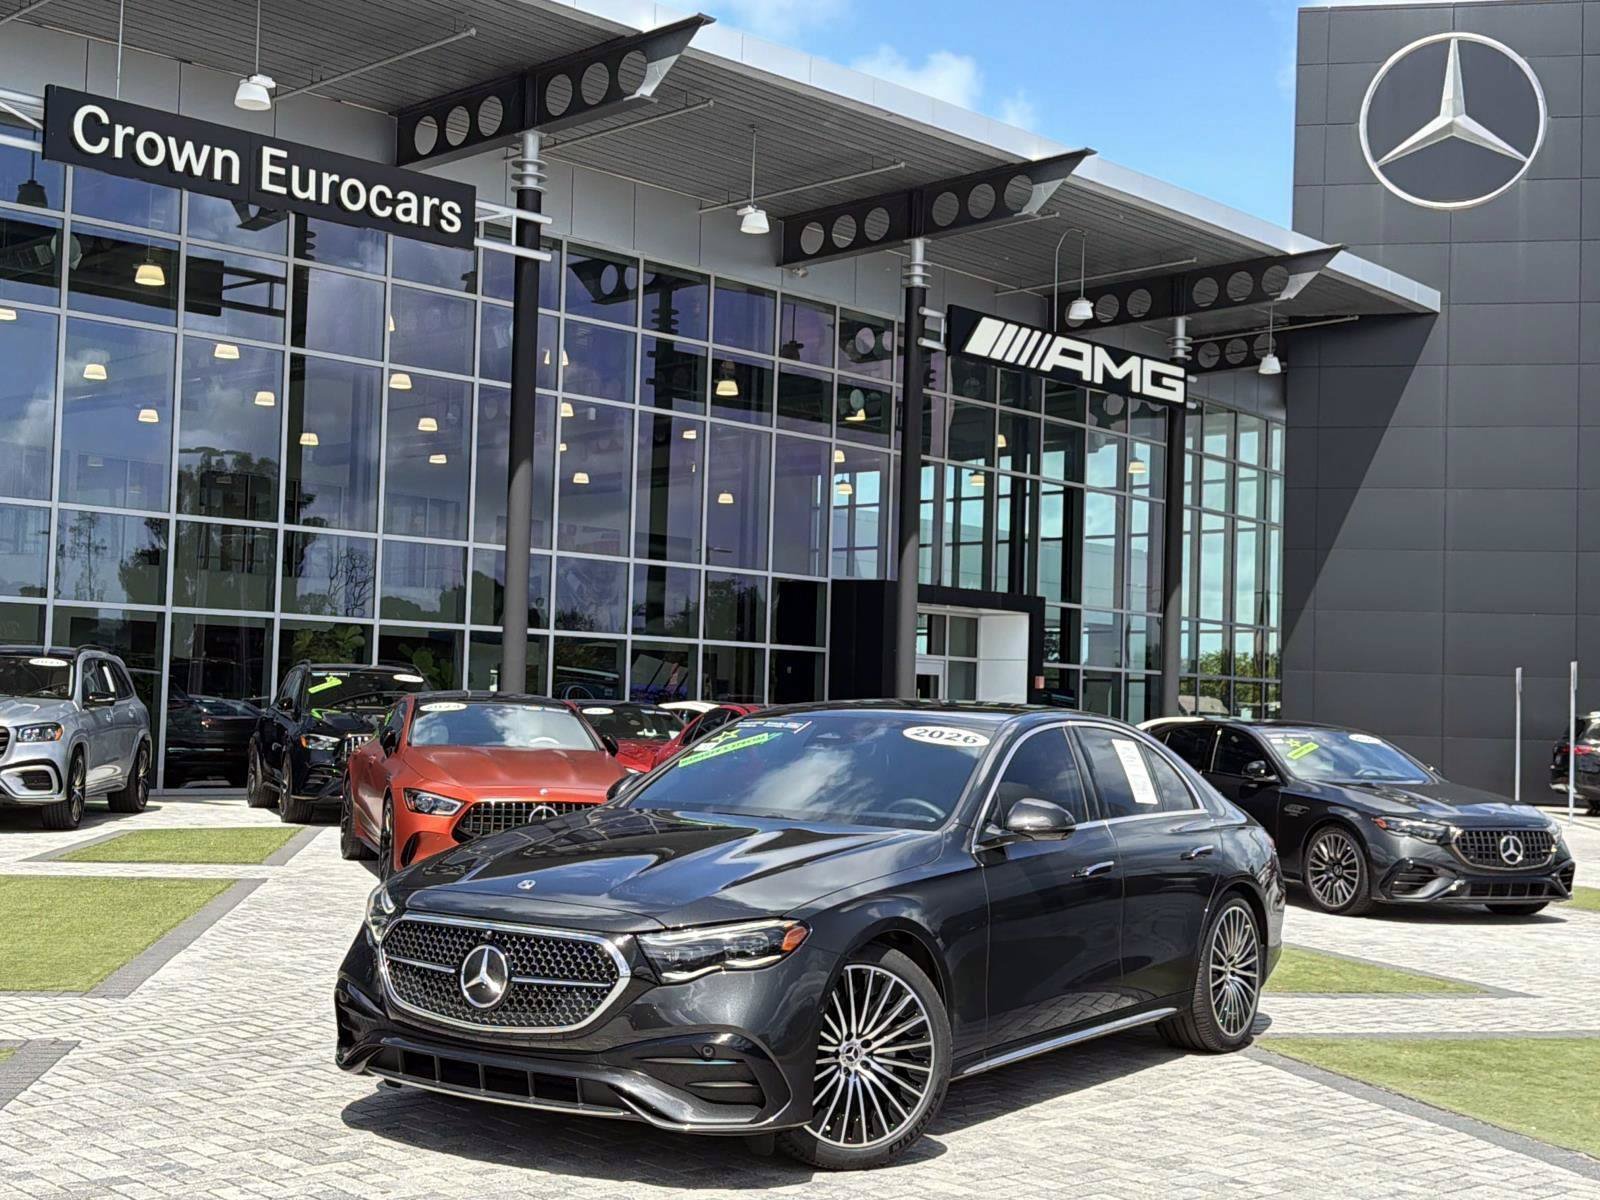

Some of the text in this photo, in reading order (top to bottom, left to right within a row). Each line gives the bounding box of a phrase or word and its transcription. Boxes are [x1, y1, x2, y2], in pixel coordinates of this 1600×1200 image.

[72, 104, 463, 234] Crown Eurocars
[1039, 335, 1186, 403] AMG
[911, 728, 980, 744] 2026
